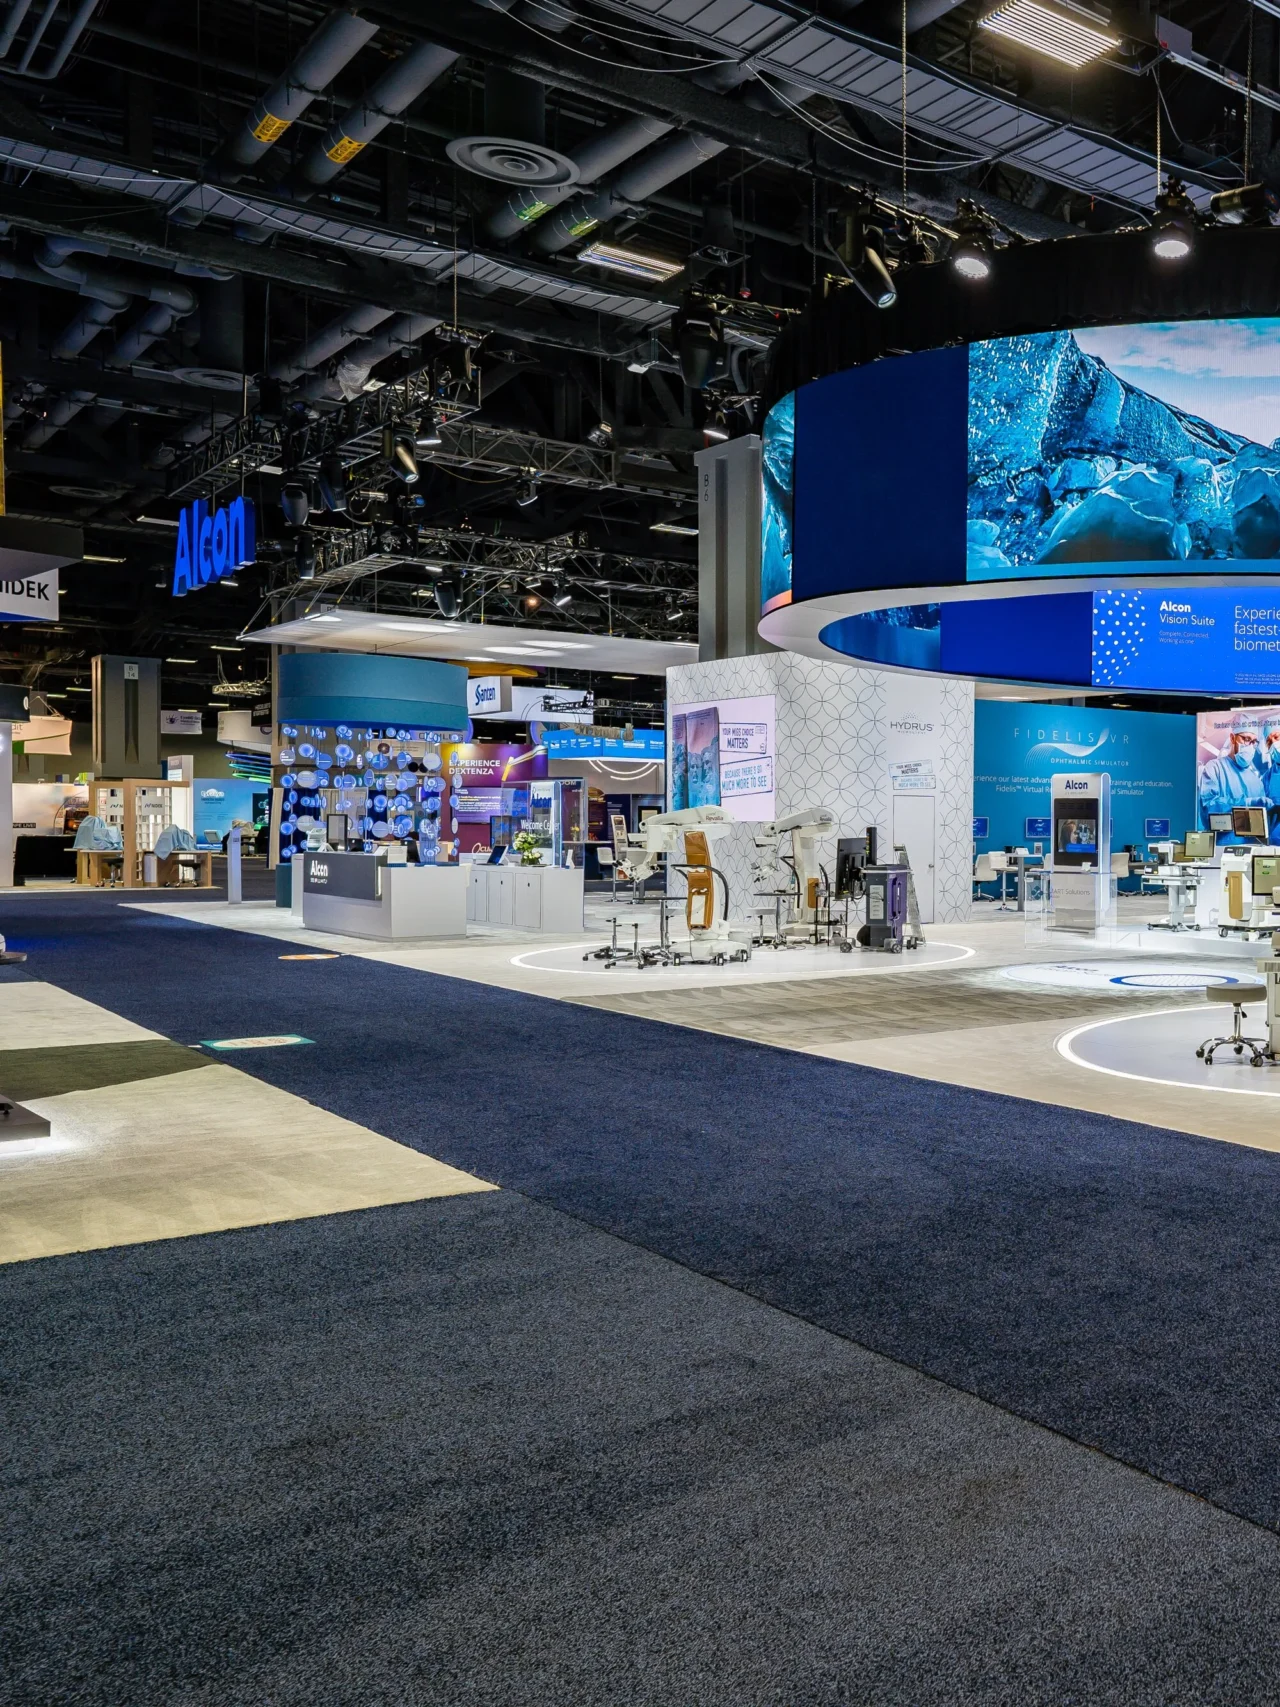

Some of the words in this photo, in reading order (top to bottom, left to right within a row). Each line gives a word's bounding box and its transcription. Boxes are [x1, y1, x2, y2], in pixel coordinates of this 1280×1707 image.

[172, 496, 252, 597] Alcon
[0, 579, 50, 601] IDEK
[1160, 601, 1191, 613] Alcon
[1159, 613, 1189, 625] Vision
[1191, 615, 1216, 626] Suite
[722, 727, 731, 736] YOUR
[742, 727, 754, 736] CHOICE
[890, 721, 933, 731] HYDRUS
[1014, 727, 1095, 742] FIDELIS
[1110, 734, 1129, 744] VR
[727, 737, 749, 749] MATTERS
[1050, 757, 1092, 766] OPHTHALMIC
[1094, 759, 1129, 767] SIMULATOR
[722, 780, 735, 791] MUCH
[757, 775, 767, 787] SEE
[1011, 774, 1029, 783] latest
[1030, 775, 1052, 784] advan
[1064, 779, 1088, 790] Alcon
[1134, 779, 1143, 787] and
[1023, 784, 1042, 793] Virtual
[1117, 787, 1144, 796] Simulator
